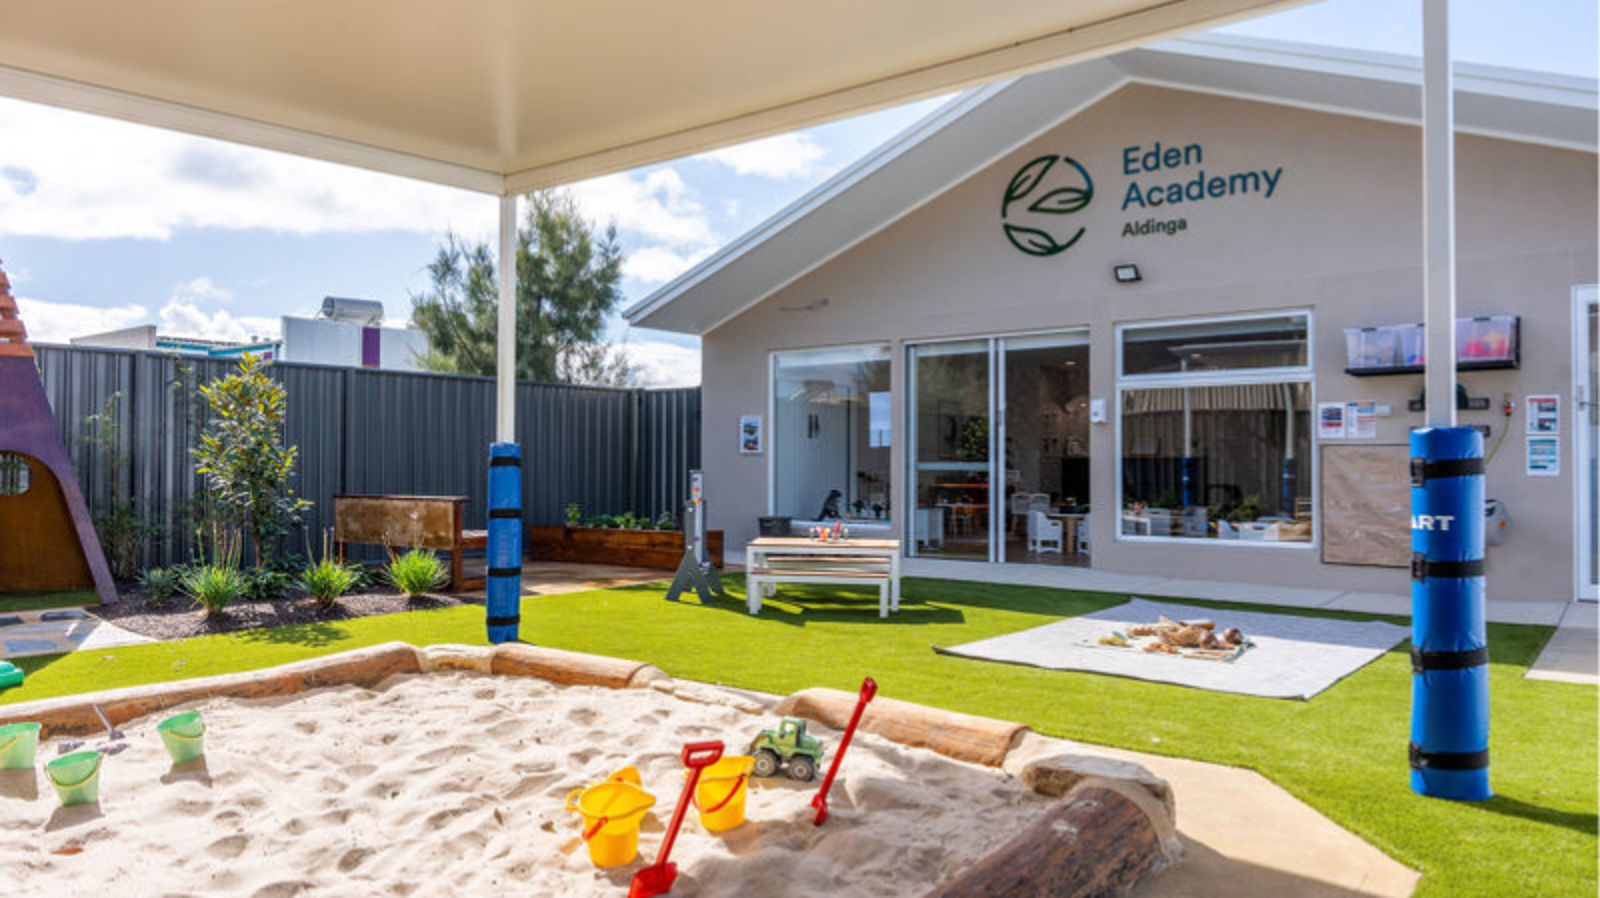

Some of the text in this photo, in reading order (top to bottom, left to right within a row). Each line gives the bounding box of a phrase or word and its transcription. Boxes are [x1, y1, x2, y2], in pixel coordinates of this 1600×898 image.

[1123, 141, 1203, 175] Eden
[1121, 167, 1283, 211] Academy
[1121, 218, 1188, 237] Aldinga
